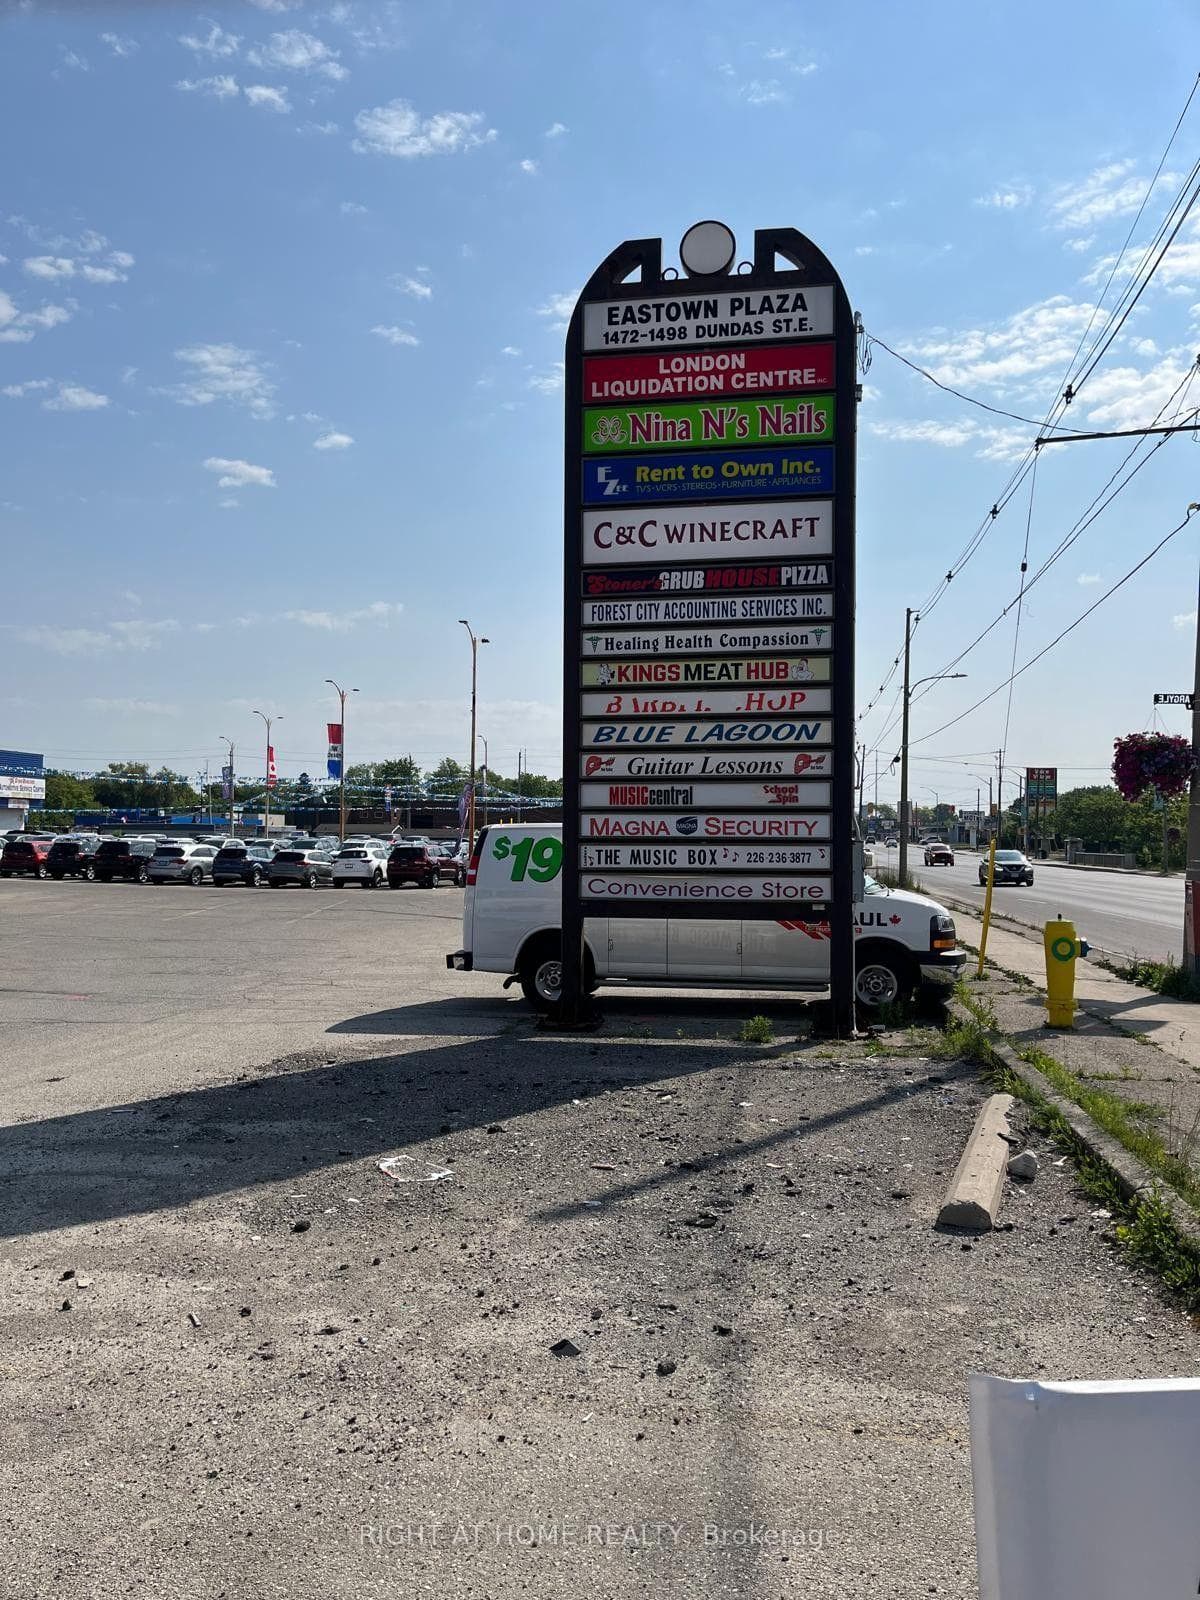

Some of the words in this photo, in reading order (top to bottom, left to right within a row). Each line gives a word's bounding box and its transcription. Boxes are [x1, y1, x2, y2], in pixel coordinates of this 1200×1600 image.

[608, 300, 718, 325] EASTOWN
[730, 293, 807, 316] PLAZA
[603, 327, 687, 345] 1472-1498
[696, 321, 763, 339] DUNDAS
[659, 354, 745, 373] LONDON
[592, 375, 724, 397] LIQUIDATION
[731, 369, 815, 388] CENTRE
[629, 412, 692, 444] Nina
[701, 408, 748, 439] N's
[759, 403, 826, 436] Nails
[637, 465, 685, 482] Rent
[692, 464, 714, 478] to
[722, 461, 773, 477] Own
[782, 459, 821, 474] Inc.
[772, 476, 821, 486] APPLIANCES
[594, 520, 657, 549] C&C
[664, 517, 820, 543] WINECRAFT
[660, 571, 704, 590] GRUB
[705, 568, 780, 587] HOUSE
[781, 565, 828, 584] PIZZA
[592, 603, 632, 621] FOREST
[637, 602, 660, 620] CITY
[664, 600, 736, 619] ACCOUNTING
[742, 599, 797, 617] SERVICES
[802, 598, 826, 615] INC.
[605, 637, 659, 652] Healing
[665, 635, 713, 649] Health
[720, 633, 809, 648] Compassion
[618, 664, 680, 682] KINGS
[684, 663, 743, 680] MEAT
[747, 662, 788, 679] HUB
[593, 726, 675, 743] BLUE
[685, 723, 821, 742] LAGOON
[628, 758, 694, 775] Guitar
[701, 757, 783, 774] Lessons
[764, 785, 798, 794] School
[590, 818, 670, 836] MAGNA
[704, 816, 818, 836] SECURITY
[596, 849, 620, 864] THE
[630, 849, 677, 865] MUSIC
[688, 850, 717, 865] BOX
[747, 852, 811, 863] 226-236-3877
[588, 879, 752, 898] Convenience
[762, 883, 823, 898] Store
